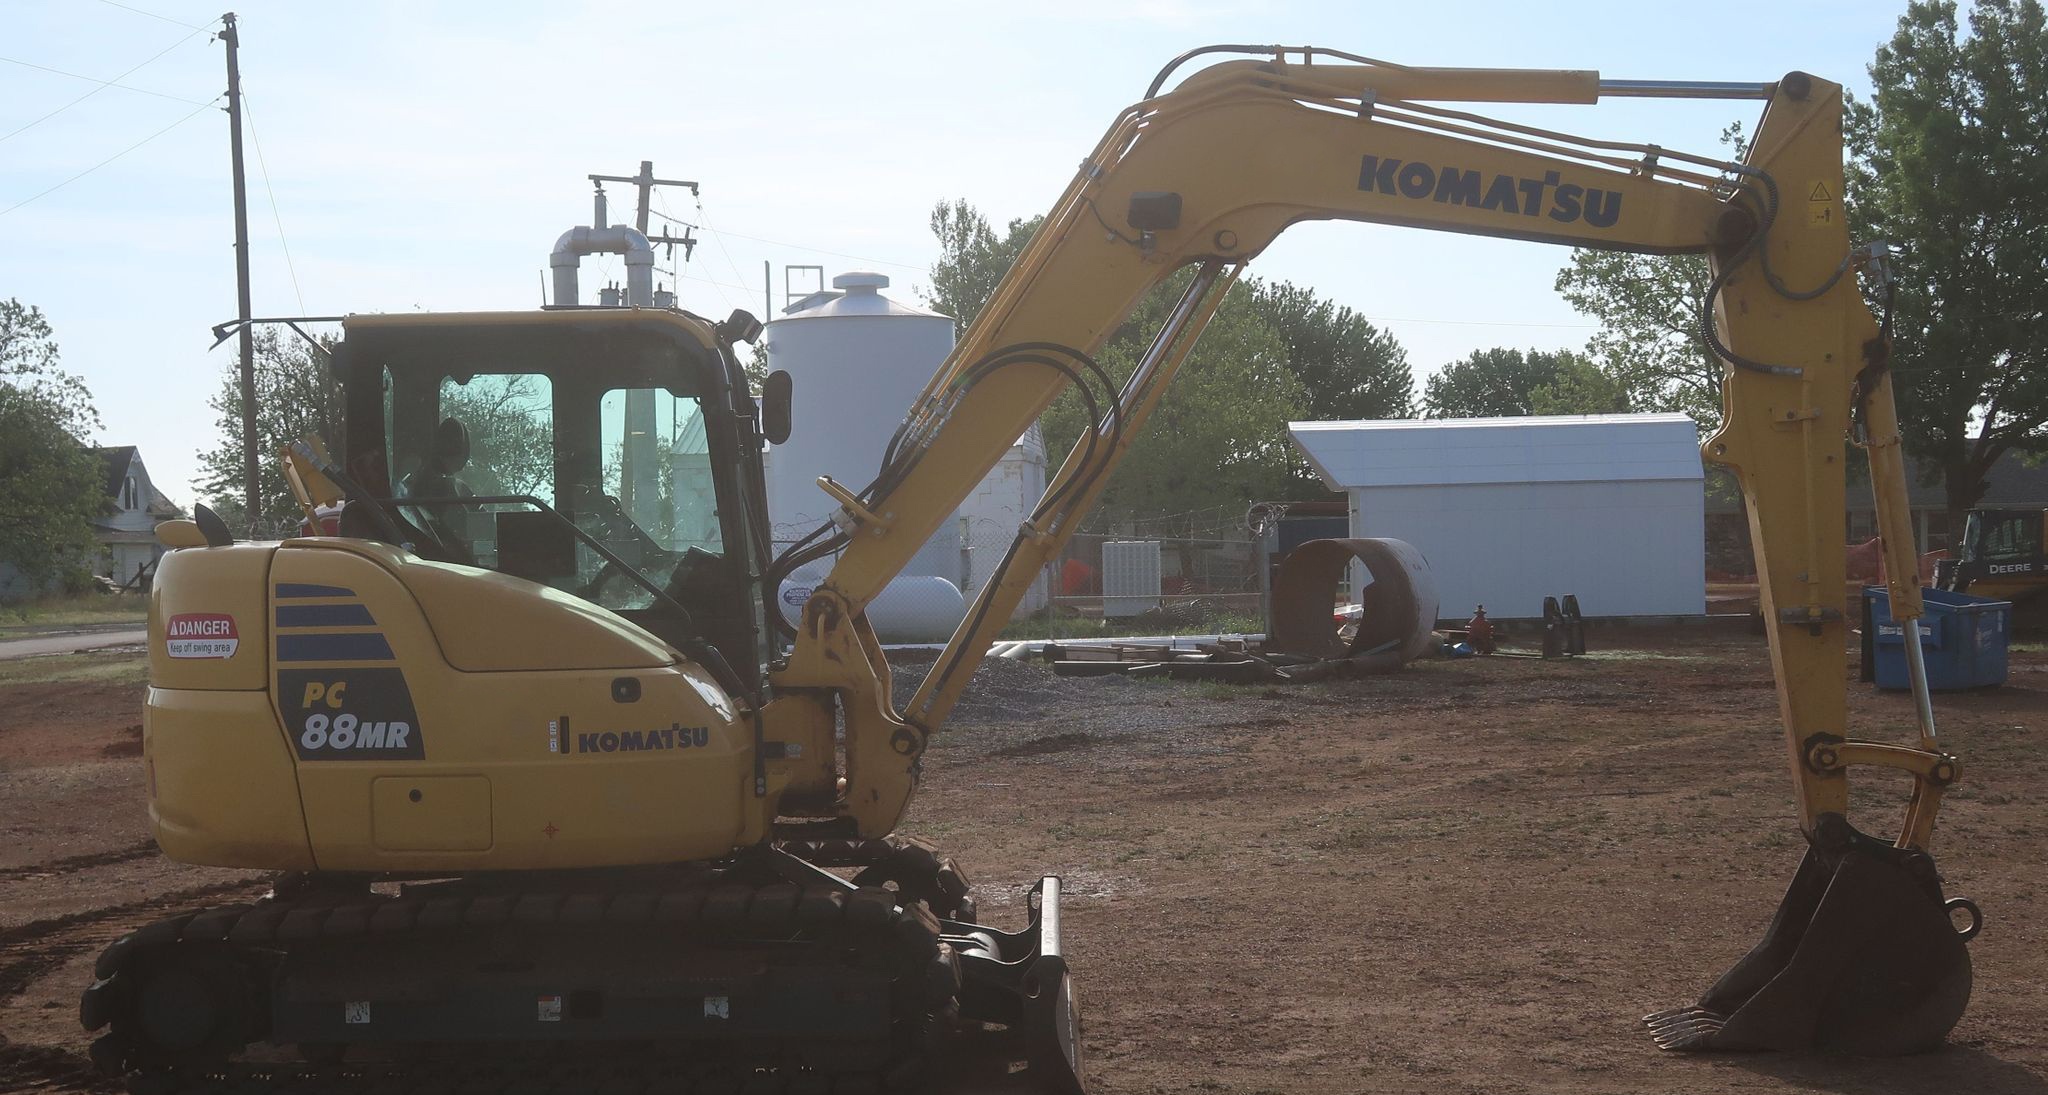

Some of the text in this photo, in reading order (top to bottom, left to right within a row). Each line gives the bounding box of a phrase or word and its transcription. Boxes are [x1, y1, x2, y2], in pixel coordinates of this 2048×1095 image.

[1357, 154, 1623, 228] KOMATSU
[1989, 563, 2032, 574] DEERE
[180, 621, 229, 635] DANGER
[170, 642, 231, 654] Keep off swing area
[302, 681, 346, 708] PC
[301, 713, 410, 749] 88MR
[578, 722, 708, 753] KOMATSU
